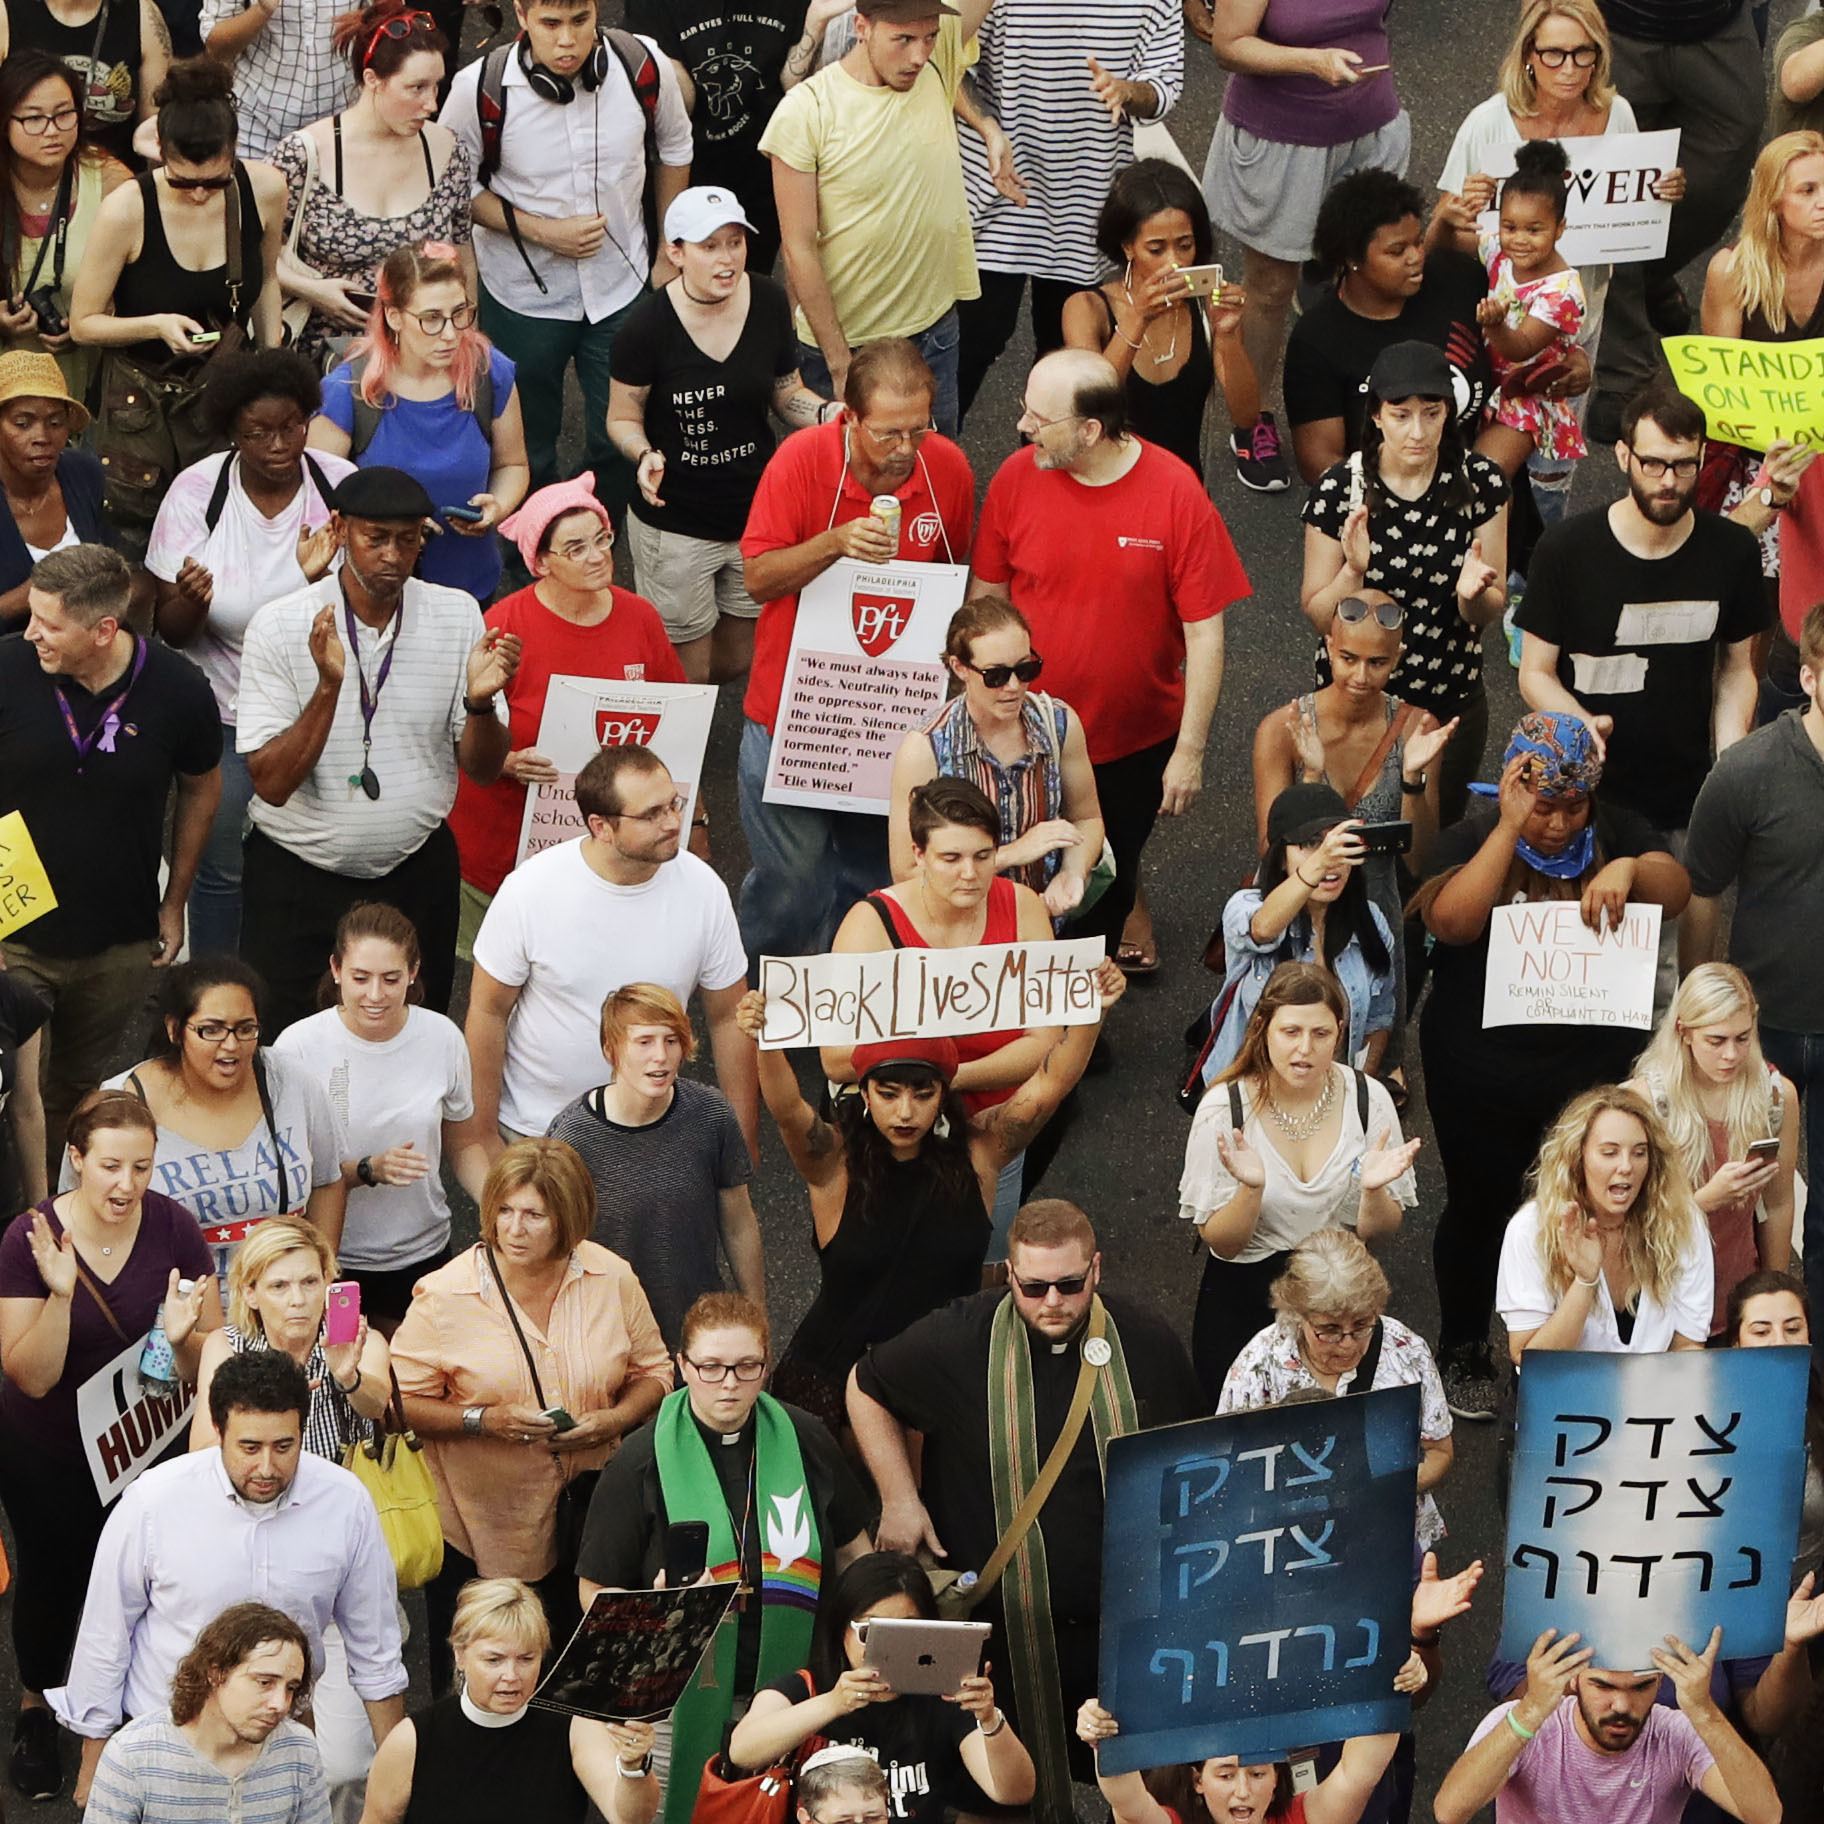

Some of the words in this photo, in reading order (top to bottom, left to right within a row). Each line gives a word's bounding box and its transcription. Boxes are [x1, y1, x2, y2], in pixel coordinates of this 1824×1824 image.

[673, 384, 726, 406] NEVER
[1703, 389, 1753, 413] ON
[1768, 388, 1815, 414] THE
[676, 406, 706, 420] THE
[680, 420, 719, 437] LESS.
[1718, 419, 1759, 443] OF
[681, 442, 758, 469] PERSISTED.
[685, 436, 710, 452] SHE
[854, 573, 918, 590] PHILADELPHIA
[857, 603, 906, 644] pft
[829, 659, 861, 674] must
[864, 663, 907, 681] always
[912, 669, 939, 684] take
[796, 672, 833, 690] sides.
[837, 676, 898, 699] Neutrality
[903, 683, 939, 703] helps
[793, 691, 811, 705] the
[816, 694, 887, 716] oppressor,
[889, 700, 927, 718] never
[787, 722, 862, 742] encourages
[865, 726, 887, 742] the
[790, 707, 811, 722] the
[814, 710, 857, 728] victim.
[860, 713, 908, 733] Silence
[783, 736, 851, 758] tormenter,
[853, 746, 892, 763] never
[814, 776, 853, 793] Wiesel
[1507, 907, 1578, 947] WE
[1595, 914, 1655, 953] WILL
[1520, 951, 1603, 985] NOT
[1508, 984, 1556, 999] REMAIN
[1560, 986, 1609, 999] SILENT
[1526, 1004, 1598, 1020] COMPLIANT
[155, 1125, 301, 1198] RELAX
[1552, 1410, 1743, 1467] צדק
[1172, 1433, 1338, 1517] צדק
[1542, 1475, 1734, 1530] צדק
[1173, 1518, 1341, 1602] צדק
[1511, 1543, 1762, 1602] נרדוף
[1147, 1615, 1382, 1708] נרדוף
